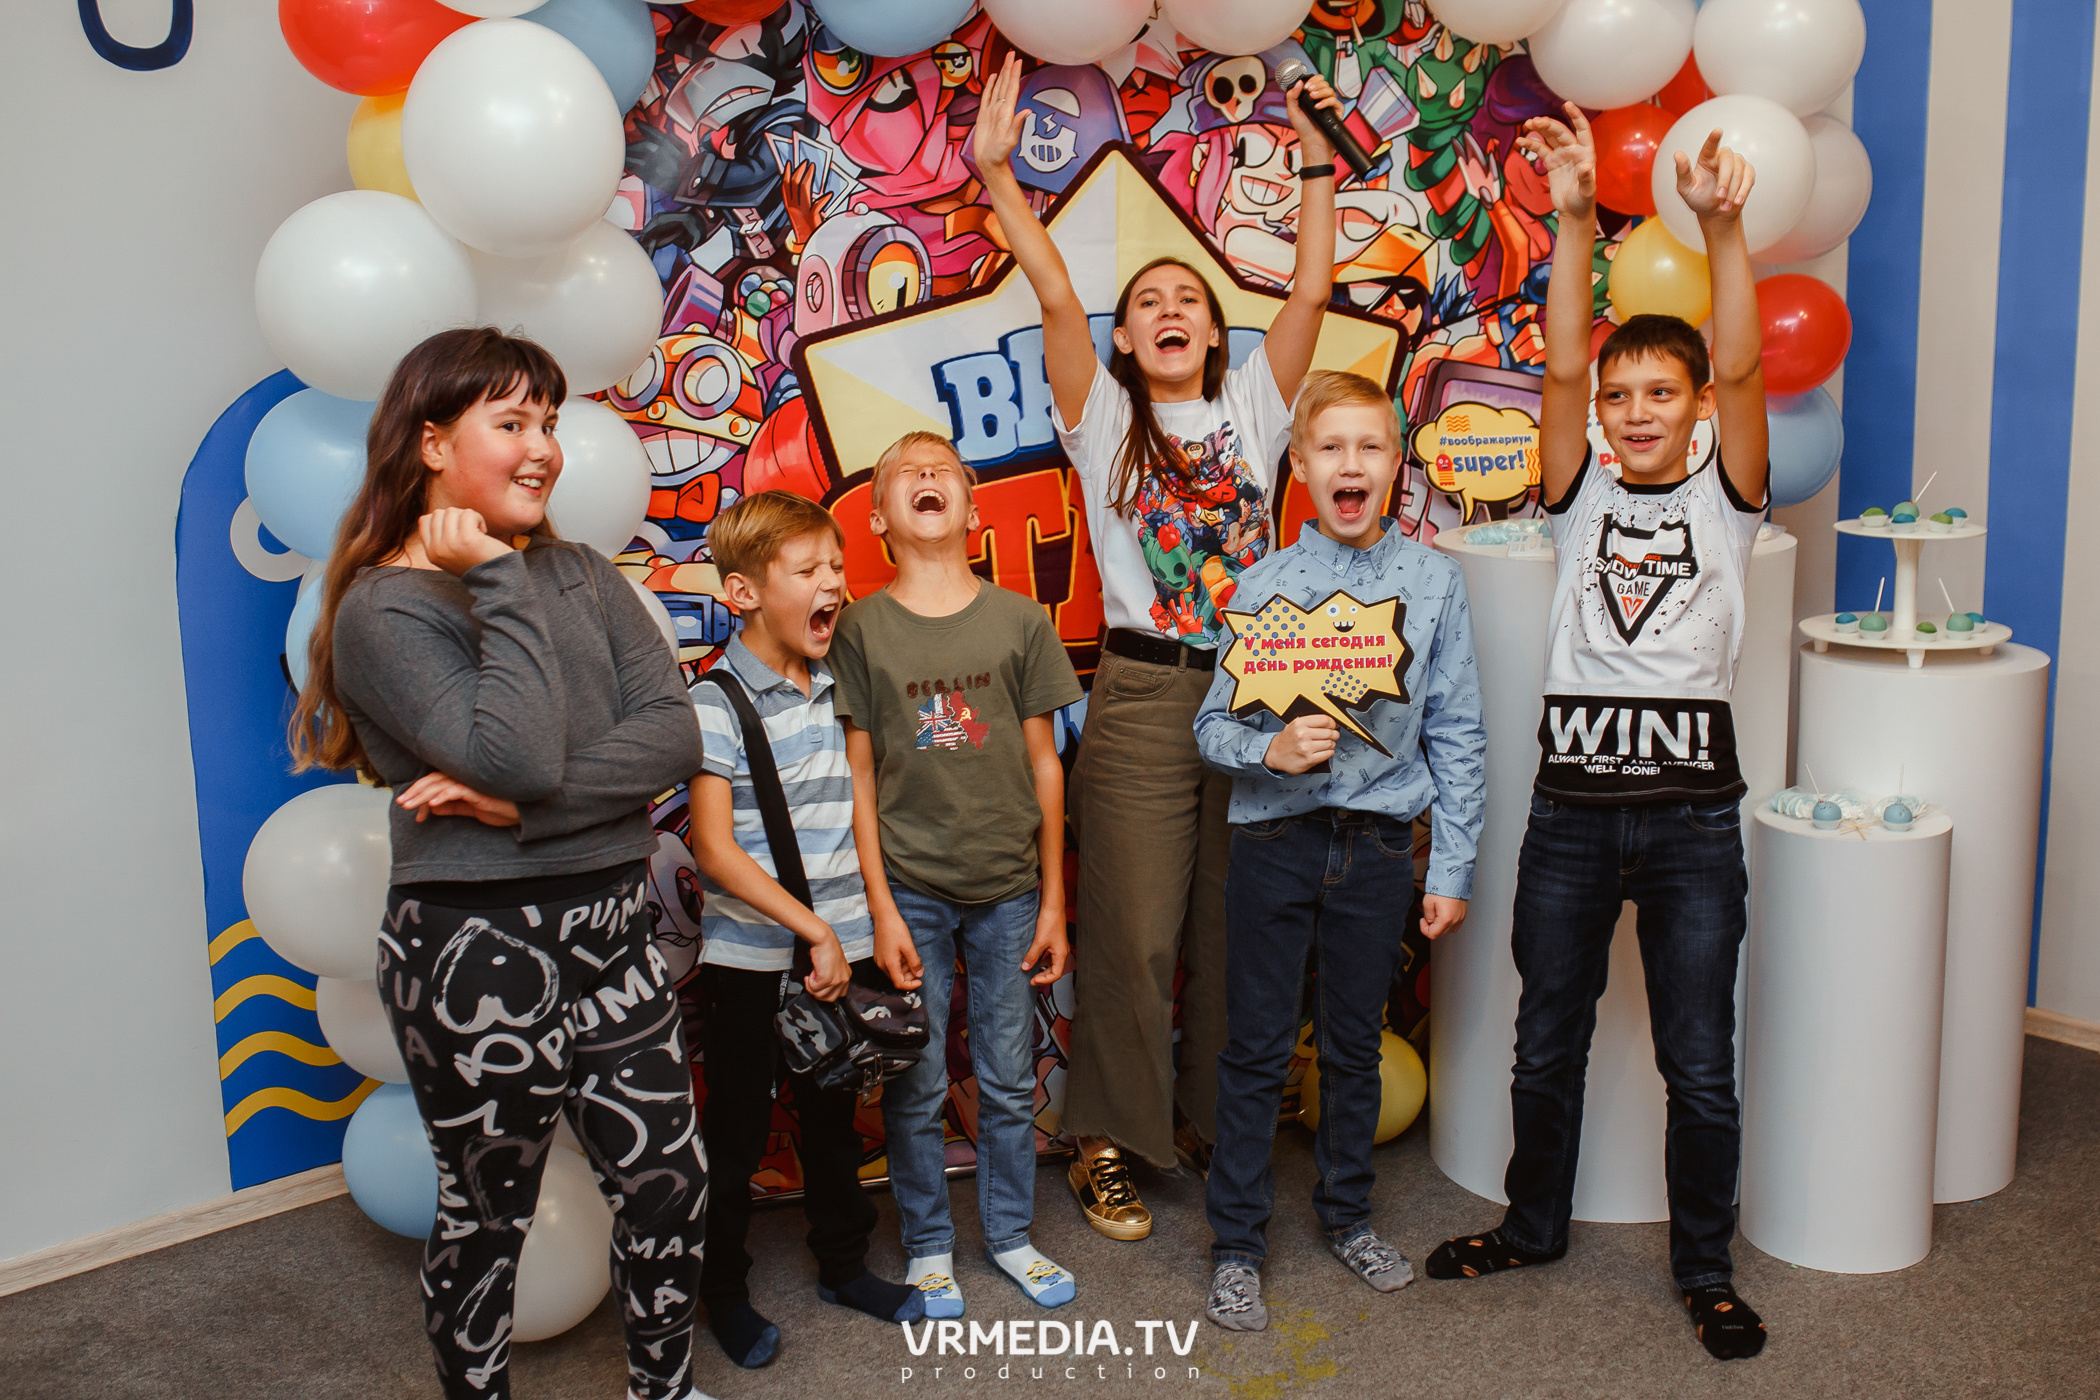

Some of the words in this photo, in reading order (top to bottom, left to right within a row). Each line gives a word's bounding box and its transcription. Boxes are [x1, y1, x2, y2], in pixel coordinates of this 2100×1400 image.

[1440, 435, 1532, 447] #воображариум
[1453, 449, 1525, 476] super!
[1643, 560, 1692, 577] TIME
[1617, 581, 1650, 596] GAME
[1244, 636, 1256, 650] У
[1261, 636, 1306, 650] меня
[1311, 633, 1387, 650] сегодня
[1244, 659, 1288, 674] день
[1293, 653, 1394, 673] рождения!
[907, 672, 991, 698] BERLIN
[1550, 706, 1710, 761] WIN!
[1548, 754, 1588, 764] ALWAYS
[1591, 755, 1623, 765] FIRST
[1584, 764, 1616, 774] WELL
[559, 882, 649, 942] PUM
[537, 943, 668, 1071] PUMA
